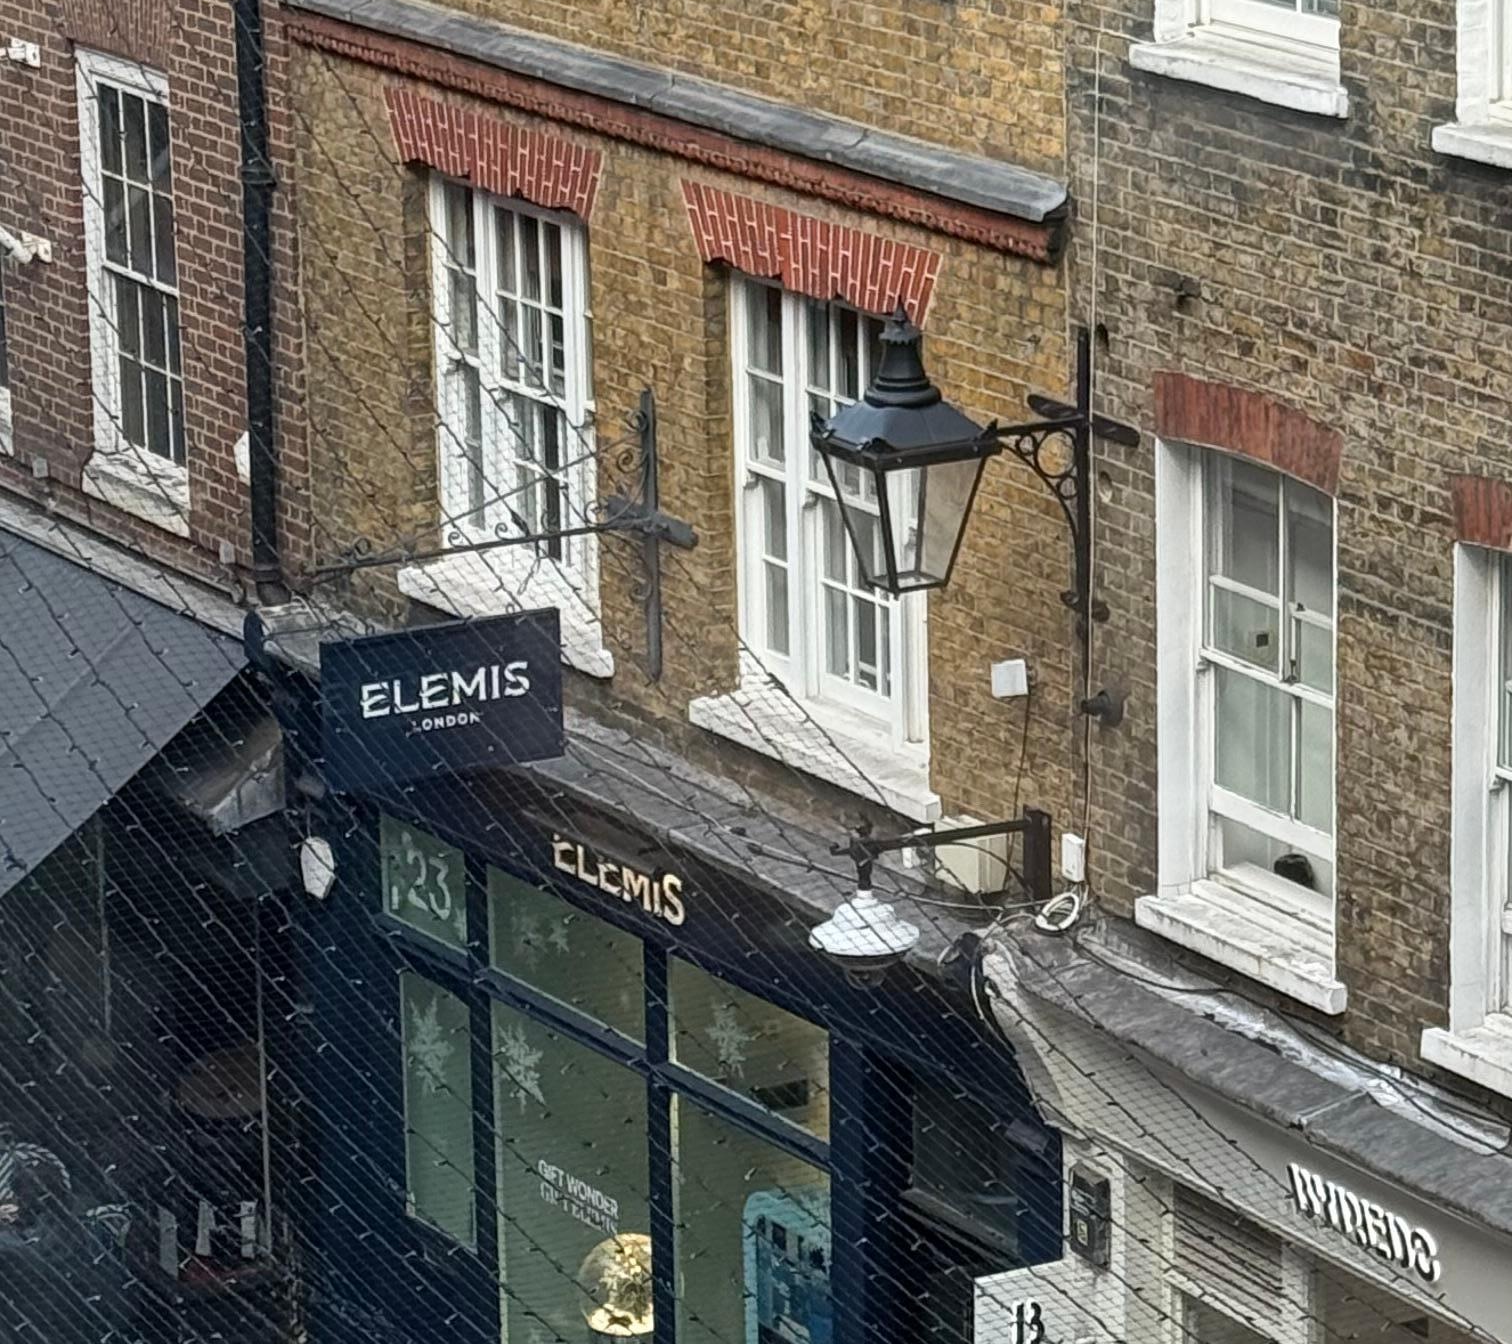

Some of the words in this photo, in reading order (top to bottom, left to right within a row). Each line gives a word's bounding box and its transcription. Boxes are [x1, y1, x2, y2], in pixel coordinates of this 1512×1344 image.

[360, 661, 530, 718] ELEMIS
[411, 712, 481, 733] LONDON
[552, 833, 685, 925] ELEMIS
[566, 1173, 619, 1219] WONDER
